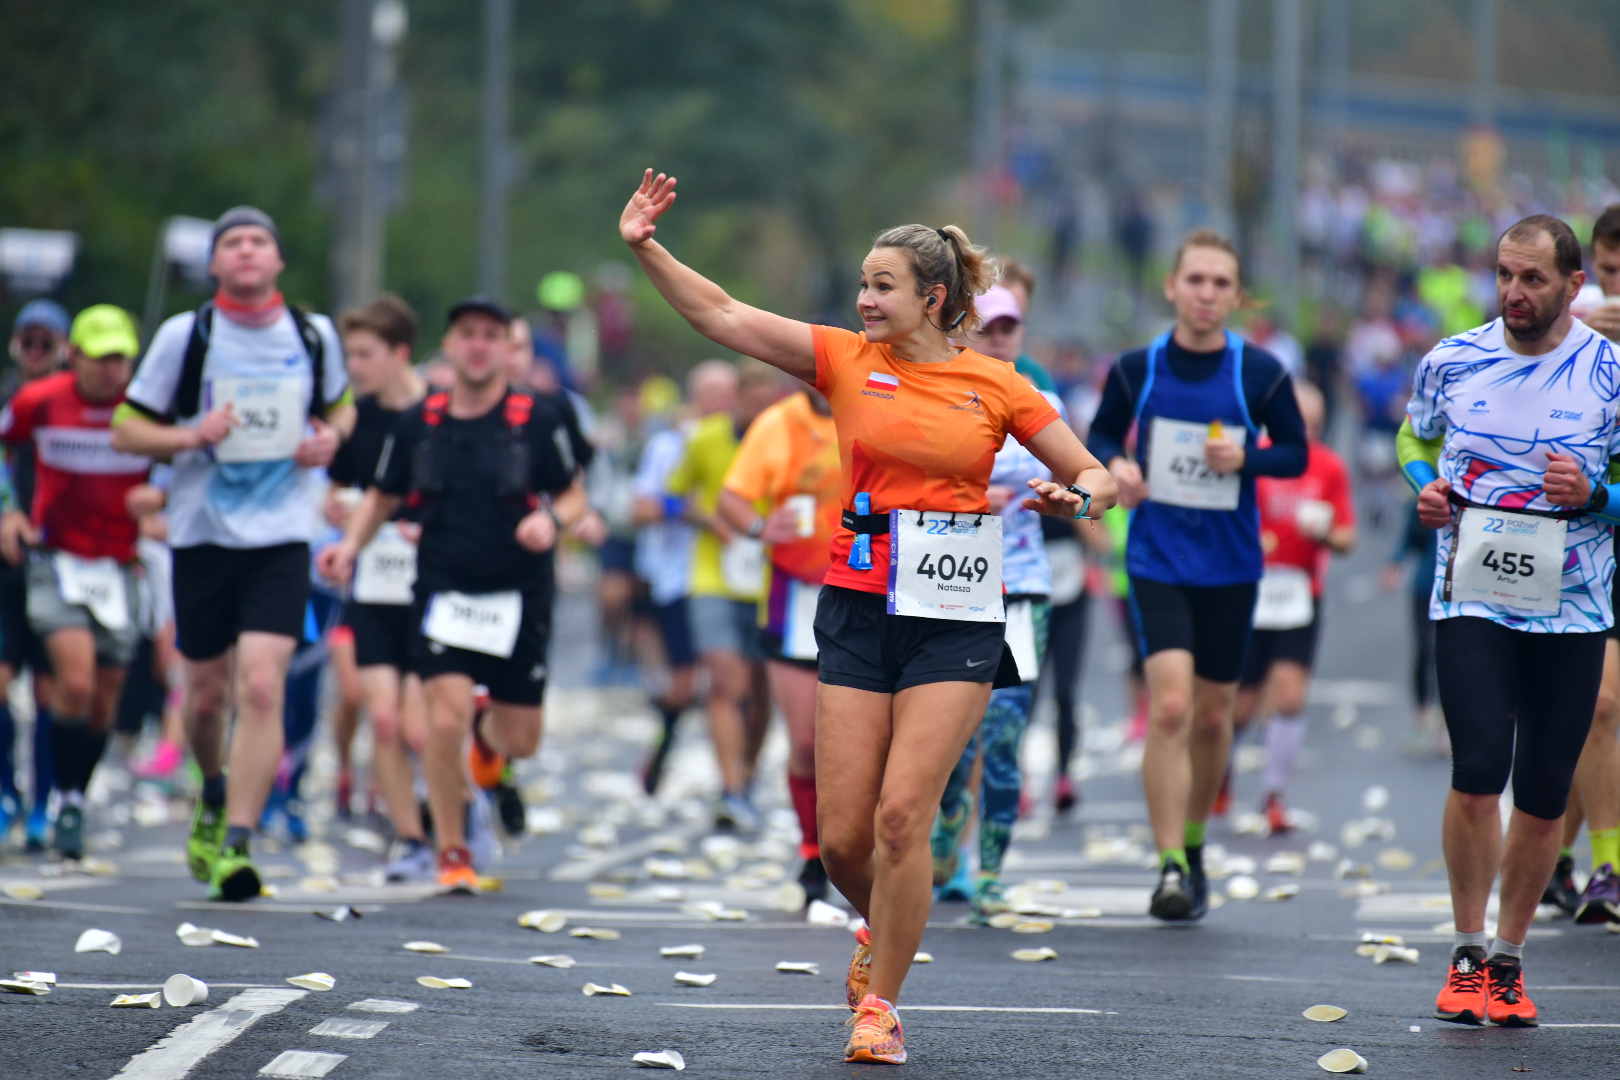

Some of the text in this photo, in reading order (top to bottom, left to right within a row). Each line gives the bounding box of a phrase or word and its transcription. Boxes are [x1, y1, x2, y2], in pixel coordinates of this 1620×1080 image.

[861, 389, 895, 400] NATASZA
[1549, 409, 1563, 419] 22
[926, 519, 949, 535] 22
[1482, 517, 1505, 533] 22
[1506, 526, 1538, 535] maraton
[917, 553, 989, 583] 4049
[1482, 549, 1535, 577] 455
[1496, 575, 1519, 585] Artur
[937, 582, 971, 593] Natasza
